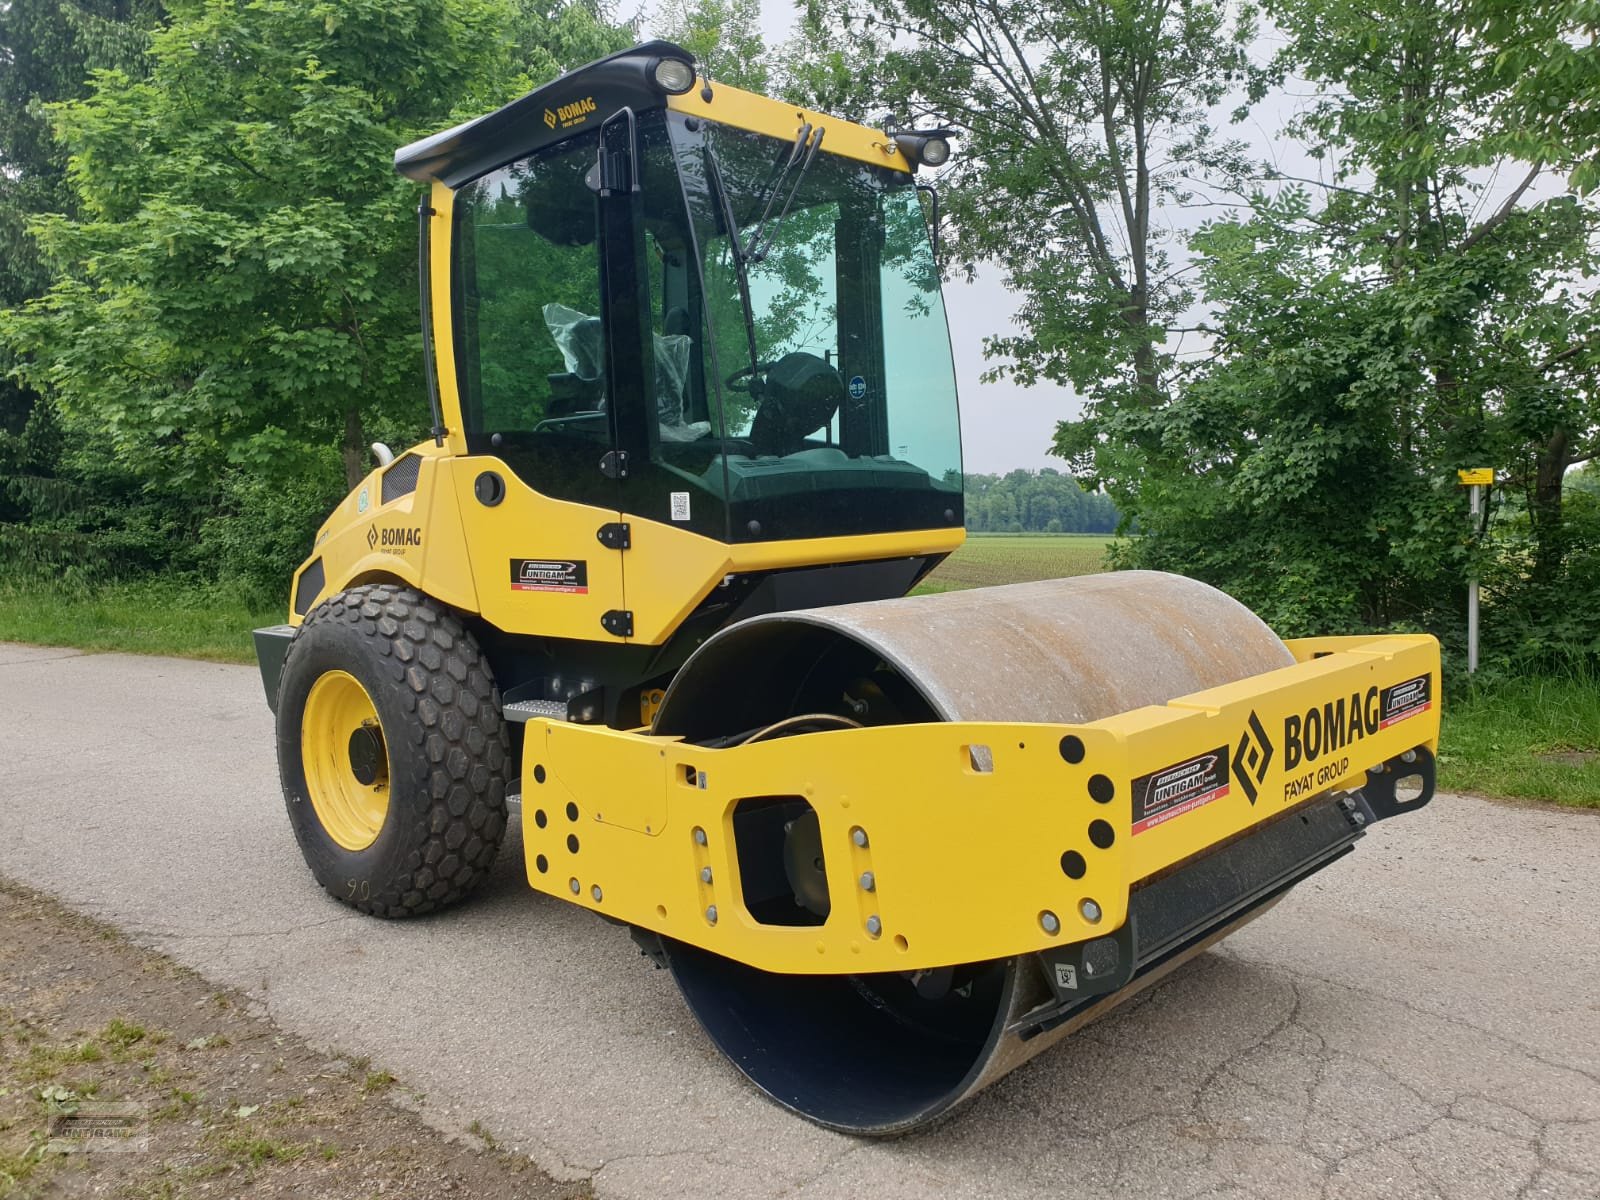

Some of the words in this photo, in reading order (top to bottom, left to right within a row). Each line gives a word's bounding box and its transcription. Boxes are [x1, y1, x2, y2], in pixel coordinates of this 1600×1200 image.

[557, 97, 596, 121] BOMAG
[381, 528, 421, 546] BOMAG
[1284, 686, 1379, 772] BOMAG
[1284, 772, 1314, 802] FAYAT
[1317, 757, 1349, 786] GROUP
